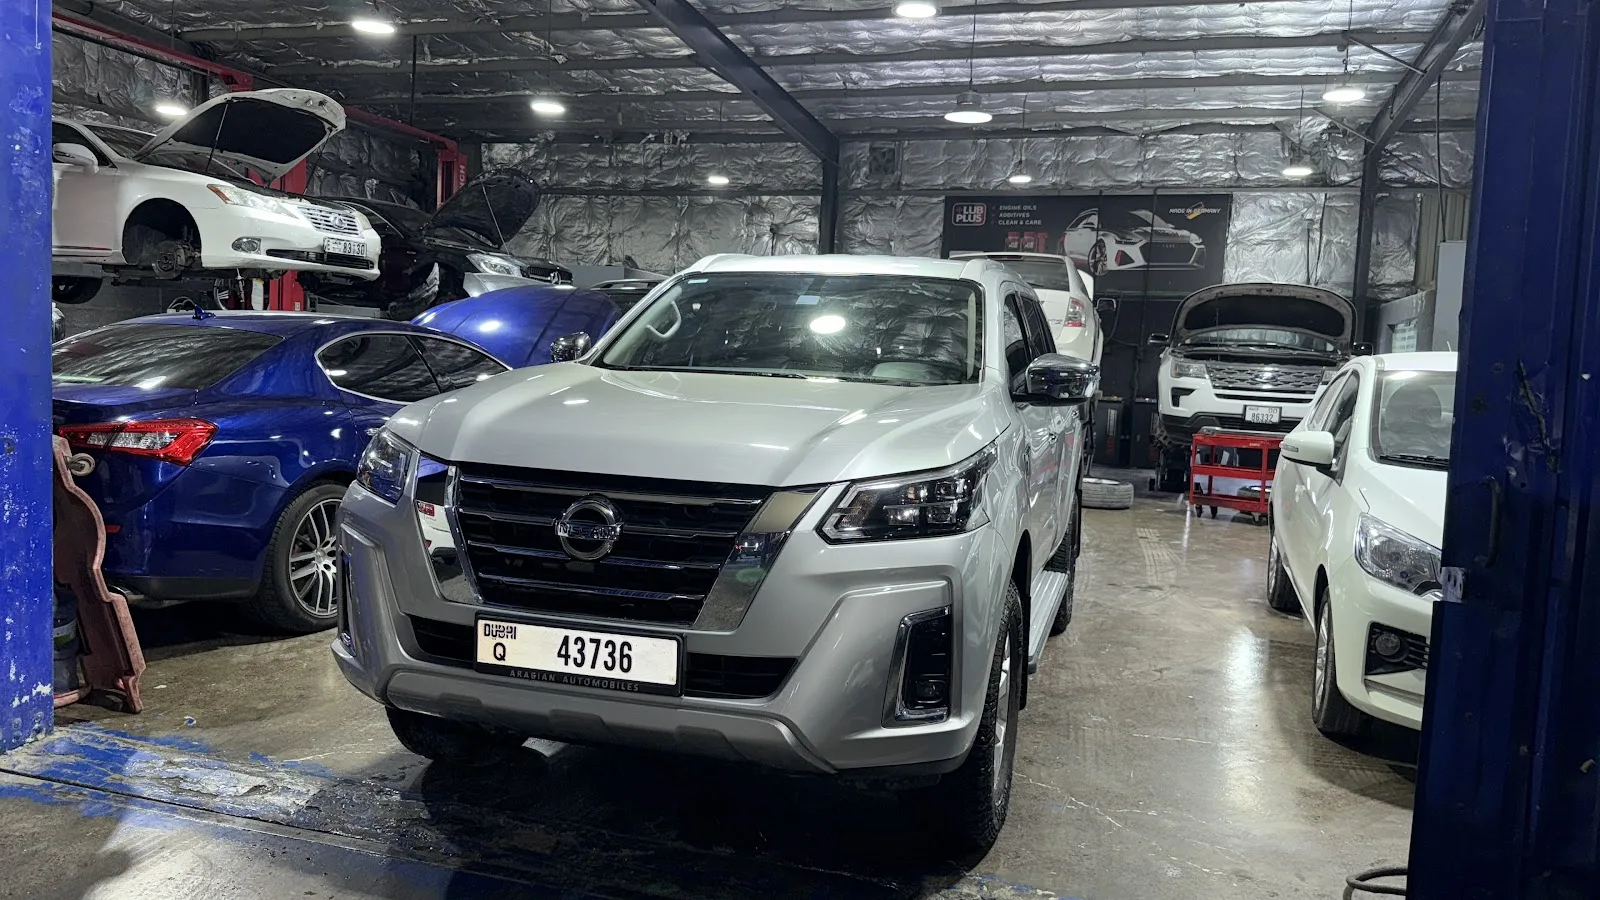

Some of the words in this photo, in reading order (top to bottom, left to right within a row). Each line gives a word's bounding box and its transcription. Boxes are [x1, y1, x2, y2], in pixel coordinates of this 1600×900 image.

[963, 205, 984, 214] LUB
[955, 214, 982, 223] PLUS
[1251, 413, 1274, 423] 86332
[484, 623, 517, 640] DUBAI
[493, 642, 506, 661] Q
[557, 635, 632, 673] 43736
[510, 669, 556, 682] ARABIAN
[562, 675, 640, 692] AUTOMOBILES
